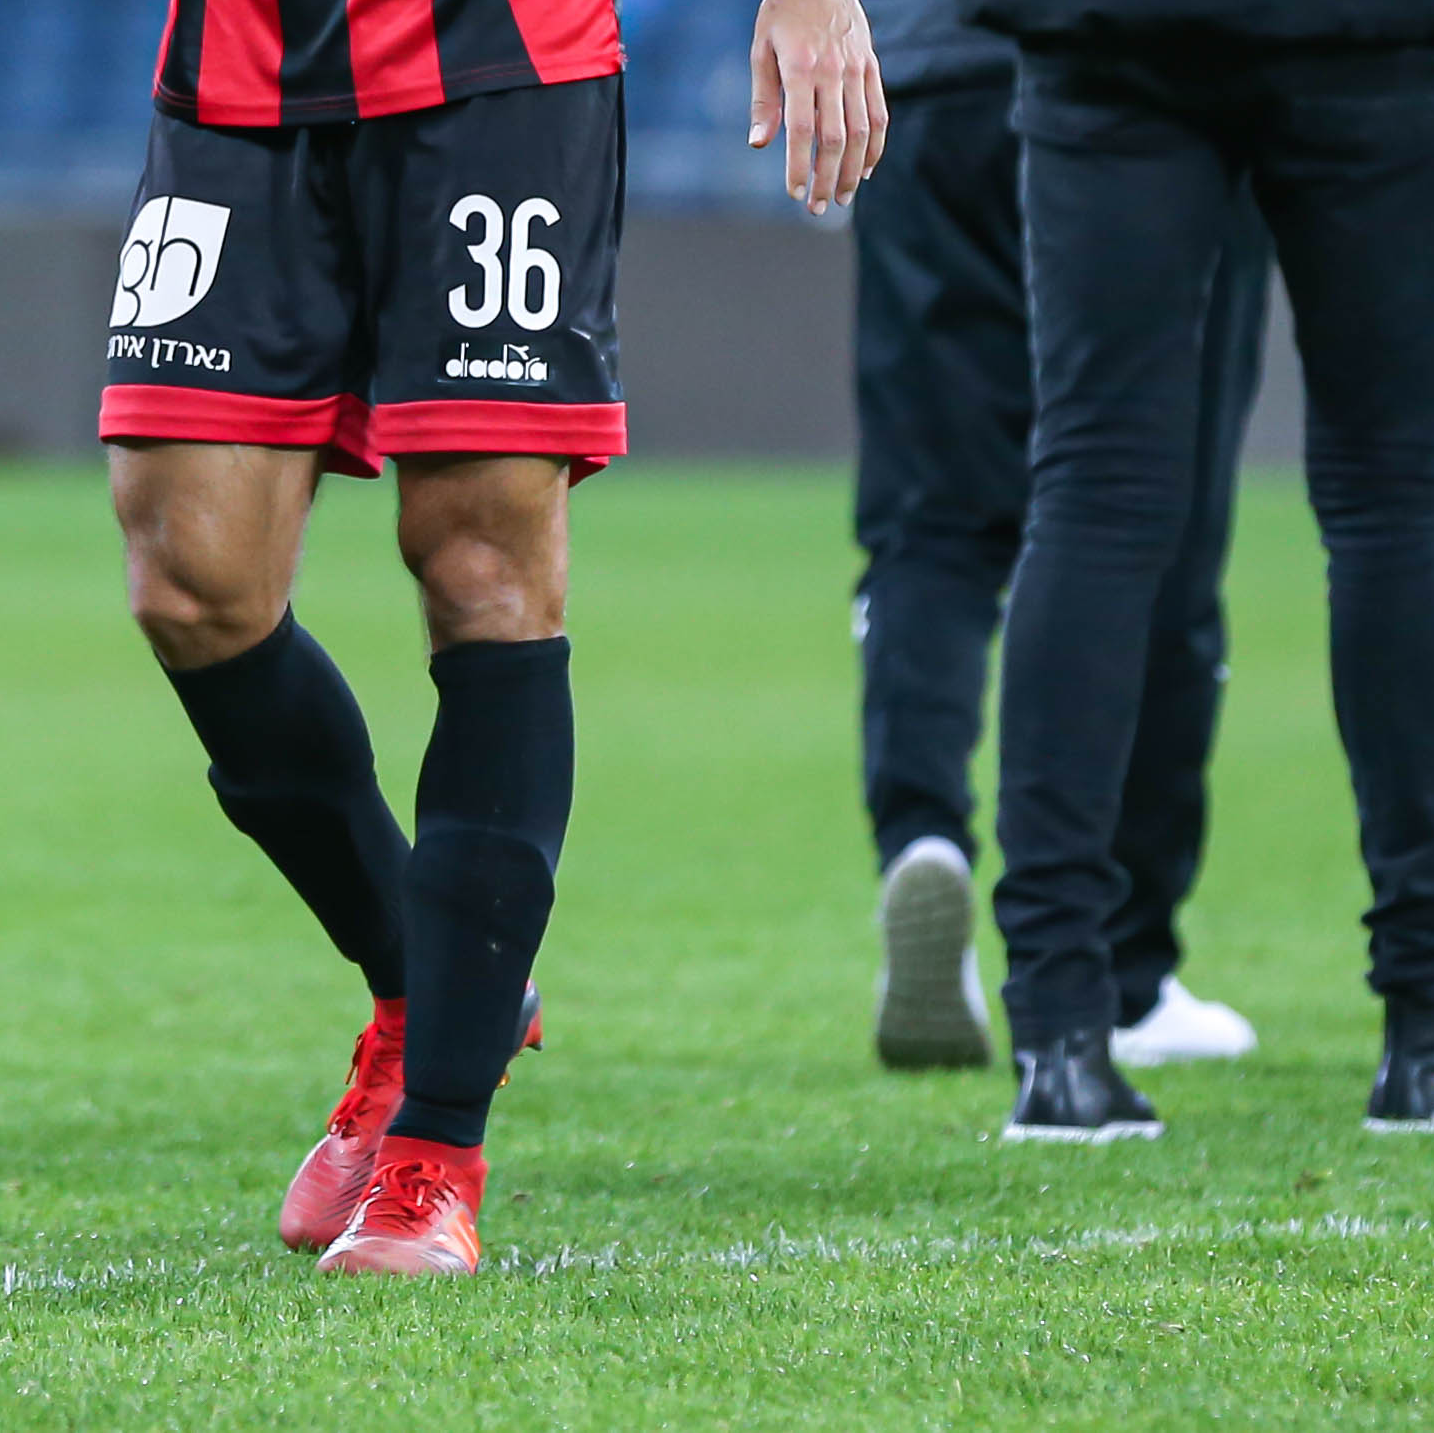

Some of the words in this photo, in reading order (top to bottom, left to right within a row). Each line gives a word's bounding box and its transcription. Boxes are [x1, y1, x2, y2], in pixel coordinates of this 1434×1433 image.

[447, 194, 562, 332] 36
[151, 337, 232, 373] גארדן
[445, 342, 548, 381] diadora
